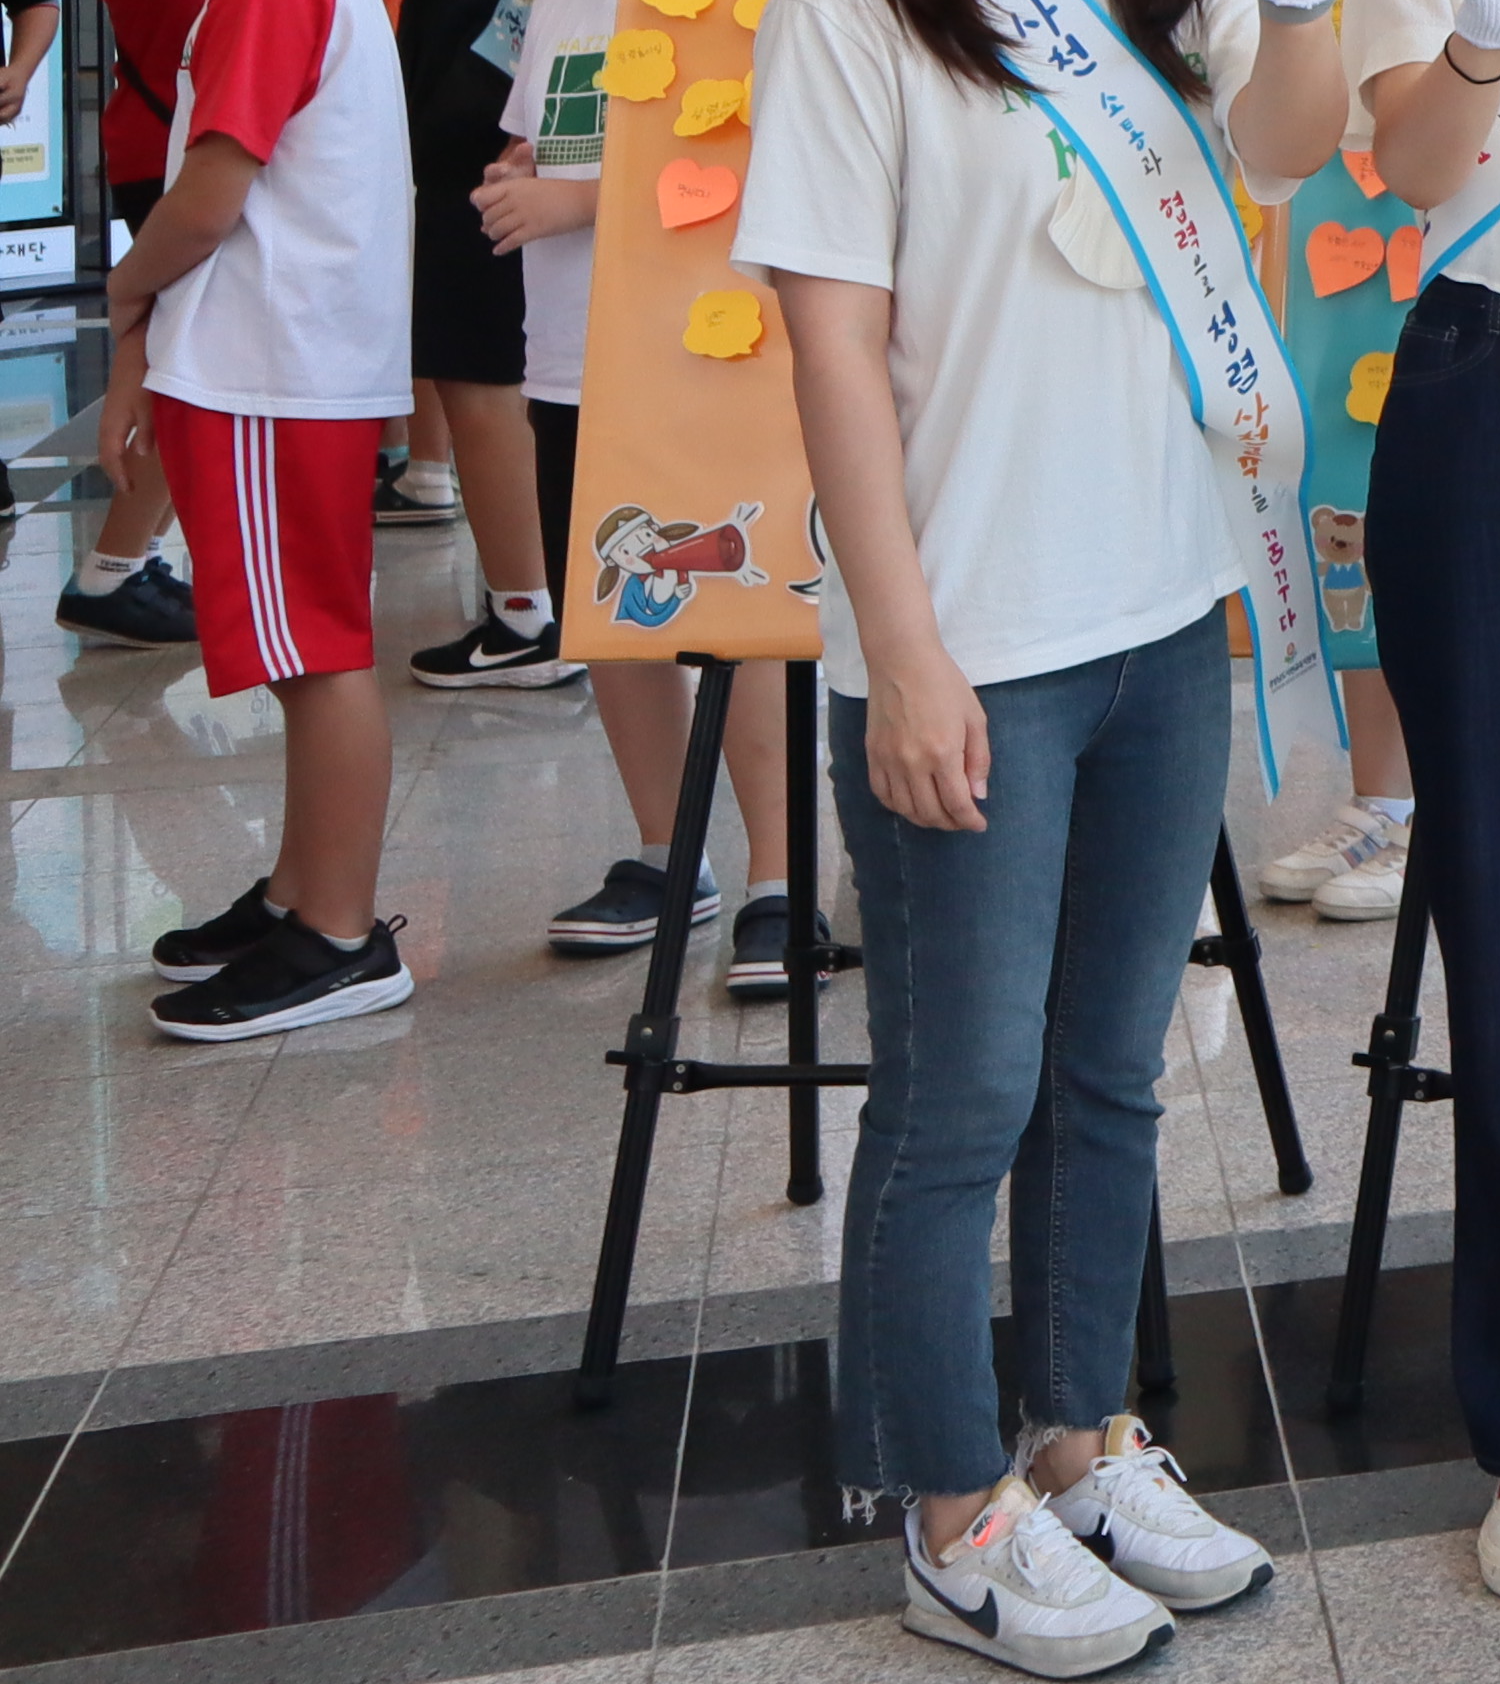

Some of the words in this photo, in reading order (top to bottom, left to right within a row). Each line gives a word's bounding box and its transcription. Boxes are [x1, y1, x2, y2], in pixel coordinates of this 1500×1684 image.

[1100, 91, 1164, 178] 소통과
[1159, 189, 1215, 299] 협력으로
[1207, 299, 1259, 395] 청렴
[1262, 528, 1297, 633] 꿈꾸다
